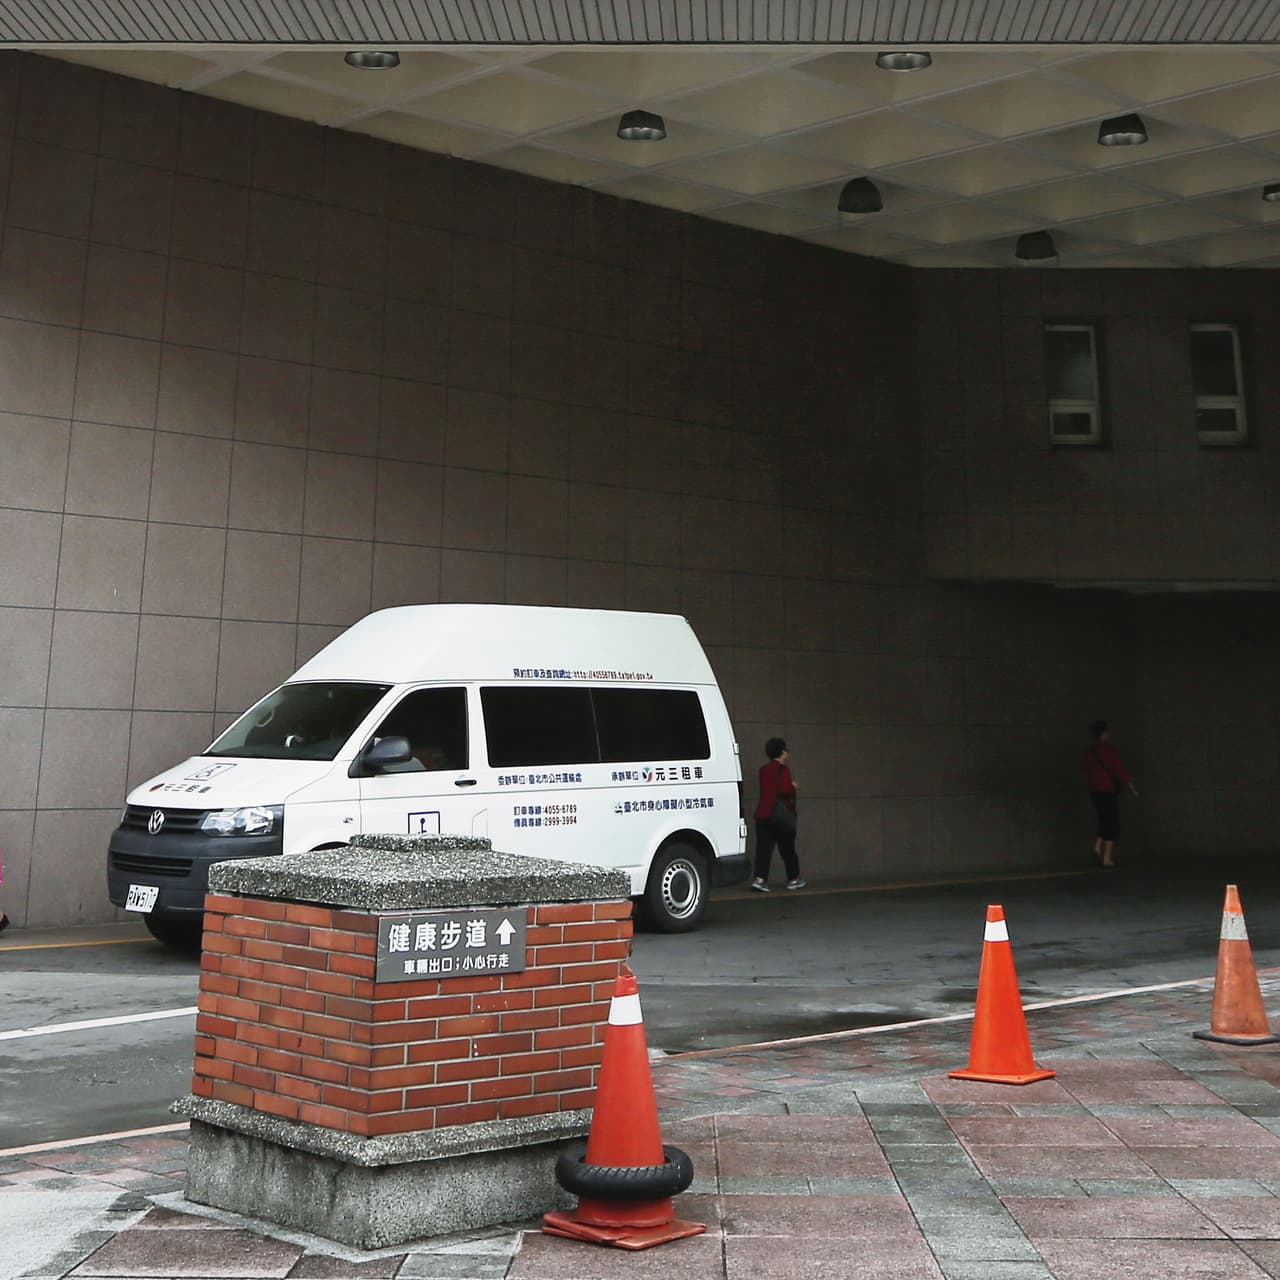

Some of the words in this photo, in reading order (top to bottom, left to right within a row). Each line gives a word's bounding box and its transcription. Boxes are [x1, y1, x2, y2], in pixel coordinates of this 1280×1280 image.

[655, 767, 704, 781] 元三租車
[388, 919, 487, 953] 健康步道
